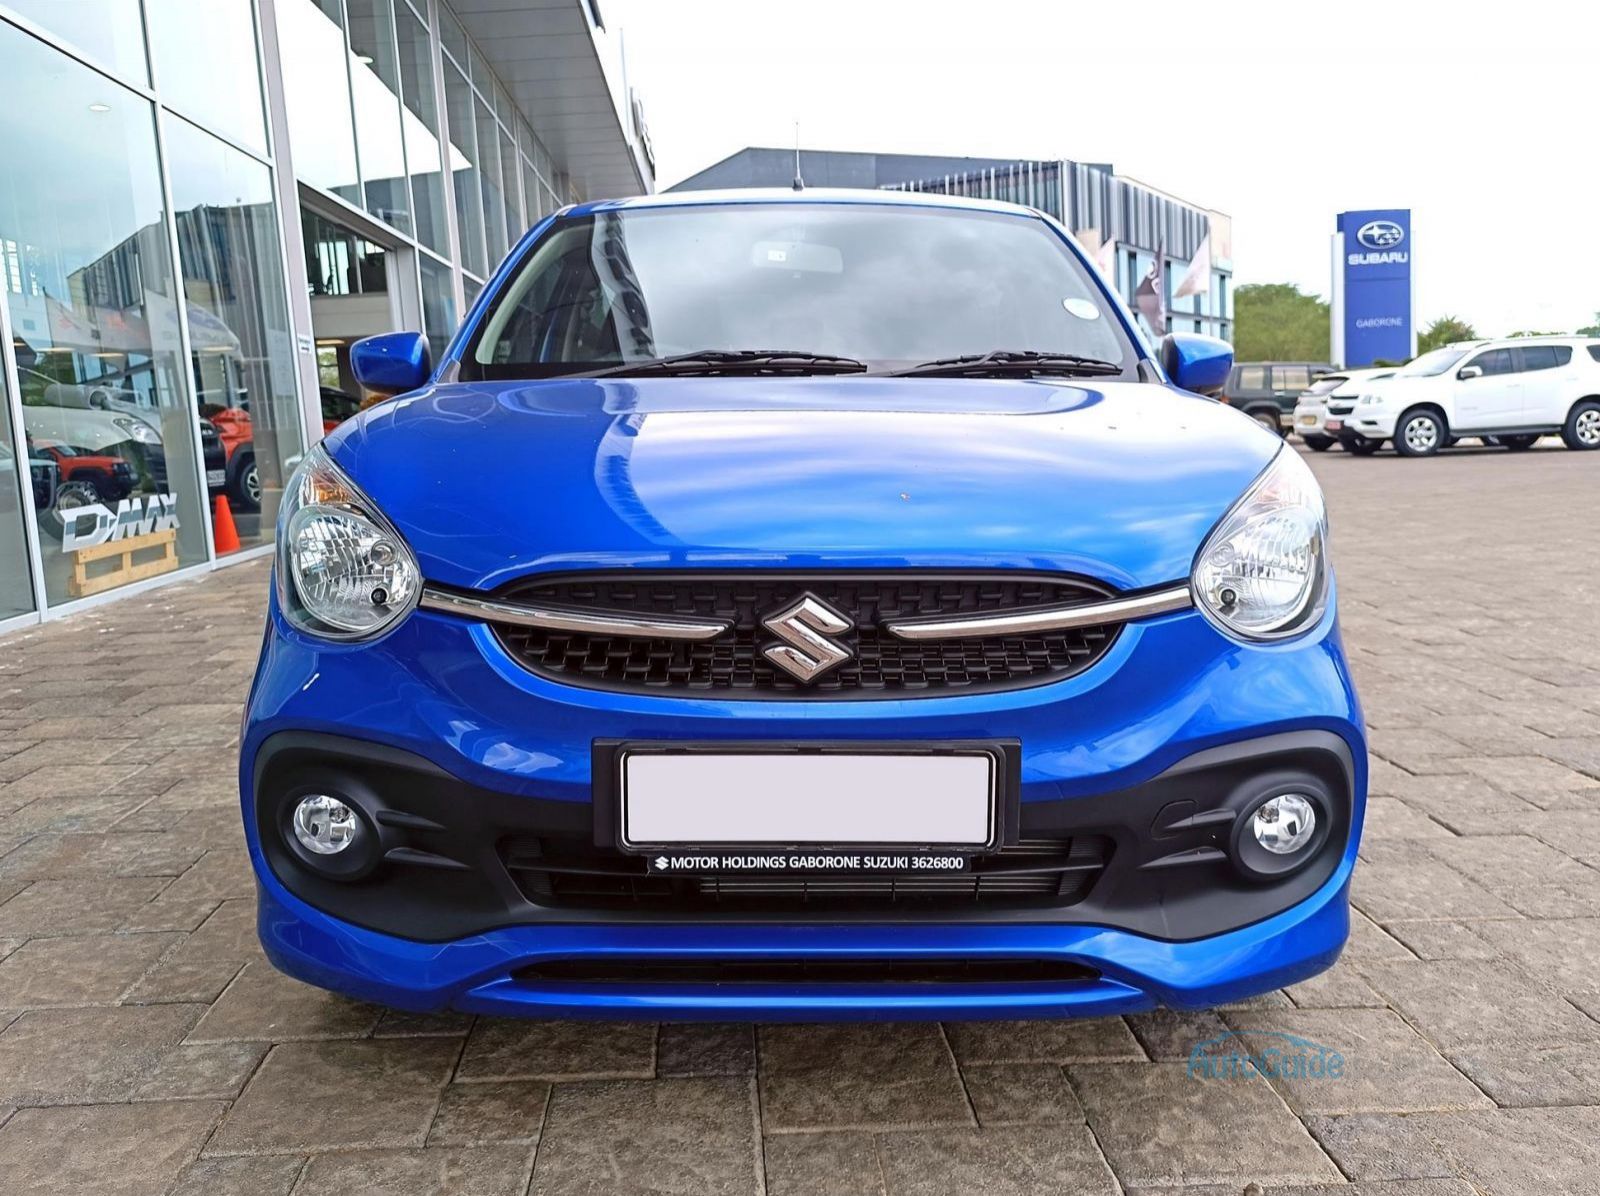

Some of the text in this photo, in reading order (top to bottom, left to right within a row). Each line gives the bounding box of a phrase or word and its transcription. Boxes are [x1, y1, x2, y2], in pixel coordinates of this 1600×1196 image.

[1347, 251, 1409, 265] SUBARU
[1355, 316, 1403, 328] GABORONE
[670, 856, 964, 869] MOTOR HOLDINGS GABORONE SUZUKI 3626800
